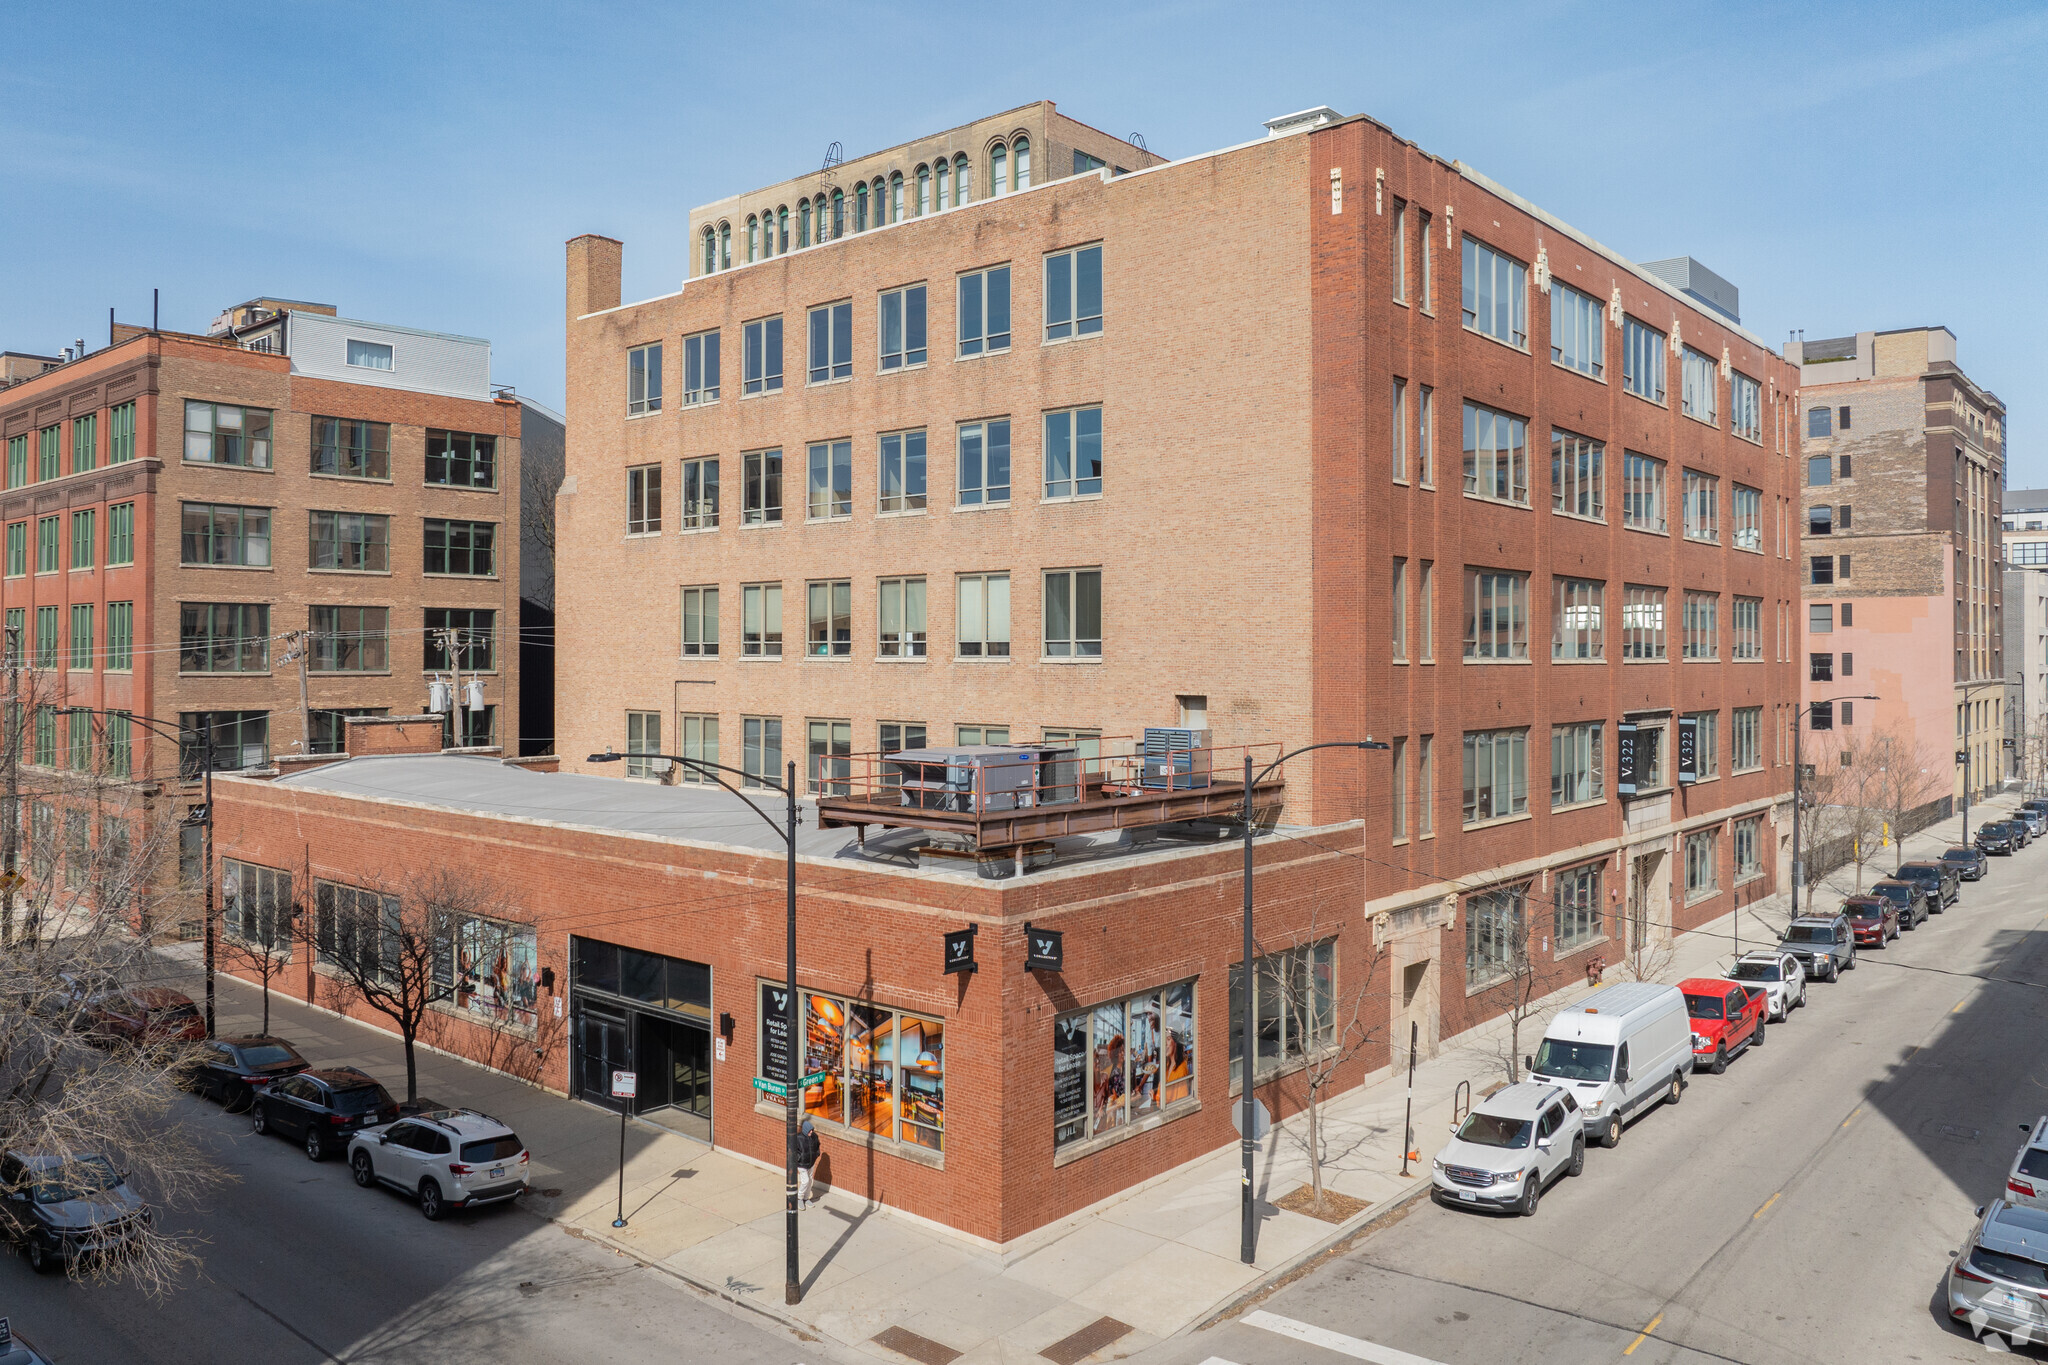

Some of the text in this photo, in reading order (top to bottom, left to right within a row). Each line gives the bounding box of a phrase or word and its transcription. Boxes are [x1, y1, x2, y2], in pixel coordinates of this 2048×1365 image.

[1682, 732, 1693, 766] V.322
[1622, 739, 1633, 777] V.322
[766, 1018, 780, 1028] Retail
[758, 1080, 768, 1089] Van
[767, 1082, 782, 1093] Buren
[802, 1077, 819, 1086] Green
[1066, 1125, 1076, 1136] JLL
